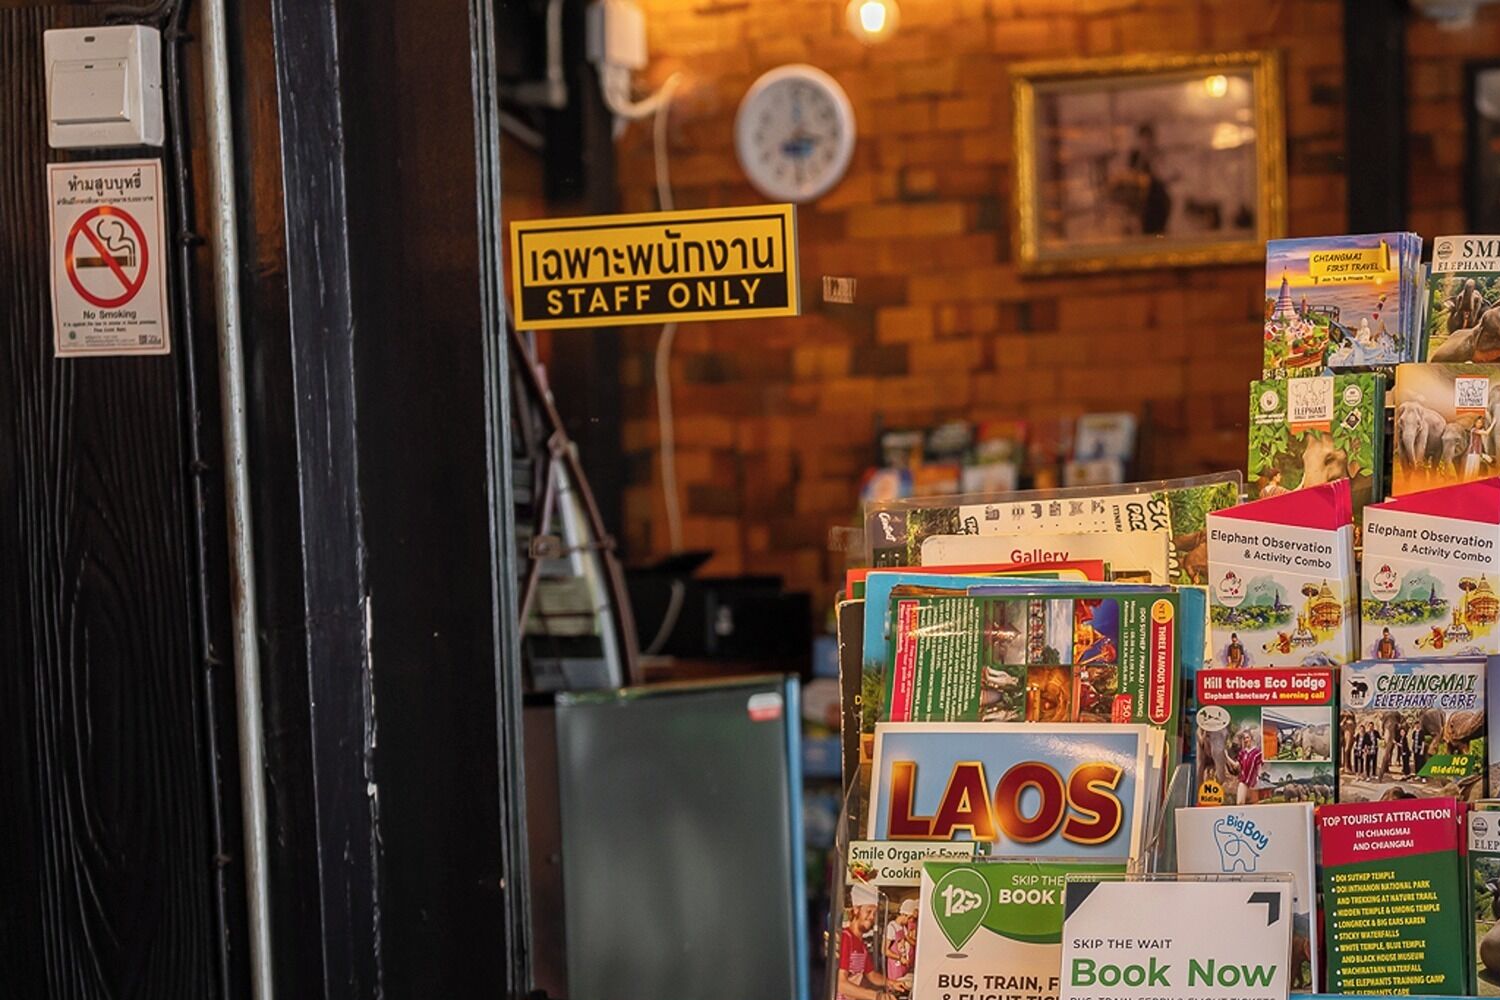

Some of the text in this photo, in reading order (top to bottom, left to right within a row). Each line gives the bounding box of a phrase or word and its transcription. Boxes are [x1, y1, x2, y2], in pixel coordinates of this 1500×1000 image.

[68, 169, 141, 196] ห้ามสูบบุหรี่
[531, 229, 774, 281] เฉพาะพนักงาน
[1314, 253, 1362, 262] CHIANGMAI
[1438, 261, 1496, 271] ELEPHANT
[547, 278, 761, 315] STAFF ONLY
[83, 310, 136, 319] No Smoking
[1294, 406, 1327, 415] ELEPHANT
[1211, 530, 1333, 555] Elephant Observation
[1367, 523, 1494, 549] Elephant Observation
[1010, 549, 1070, 563] Gallery
[1244, 549, 1332, 569] & Activity Combo
[1402, 544, 1492, 564] & Activity Combo
[1155, 626, 1166, 718] THREE FAMOUS TEMPLES
[1204, 677, 1326, 690] Hill tribes Eco lodge
[1376, 673, 1476, 693] CHIANGMAI
[1204, 692, 1233, 700] Elephant
[1235, 692, 1270, 700] Sanctuary
[1279, 692, 1309, 700] morning
[1374, 693, 1476, 708] ELEPHANT CARE
[1451, 757, 1468, 765] NO
[1430, 766, 1466, 775] Ridding
[1204, 785, 1219, 794] No
[888, 761, 1124, 844] LAOS
[1323, 809, 1451, 826] TOP TOURIST ATTRACTION
[1226, 814, 1269, 850] BigBoy
[1366, 828, 1410, 837] CHIANGMAI
[1353, 840, 1414, 851] AND CHIANGRAI
[852, 847, 933, 863] Smile Organic
[881, 867, 920, 879] Cookin
[1012, 875, 1065, 886] SKIP THE
[1000, 889, 1055, 904] BOOK
[1073, 939, 1172, 949] SKIP THE WAIT
[1071, 958, 1277, 987] Book Now
[938, 975, 1042, 991] BUS, TRAIN,
